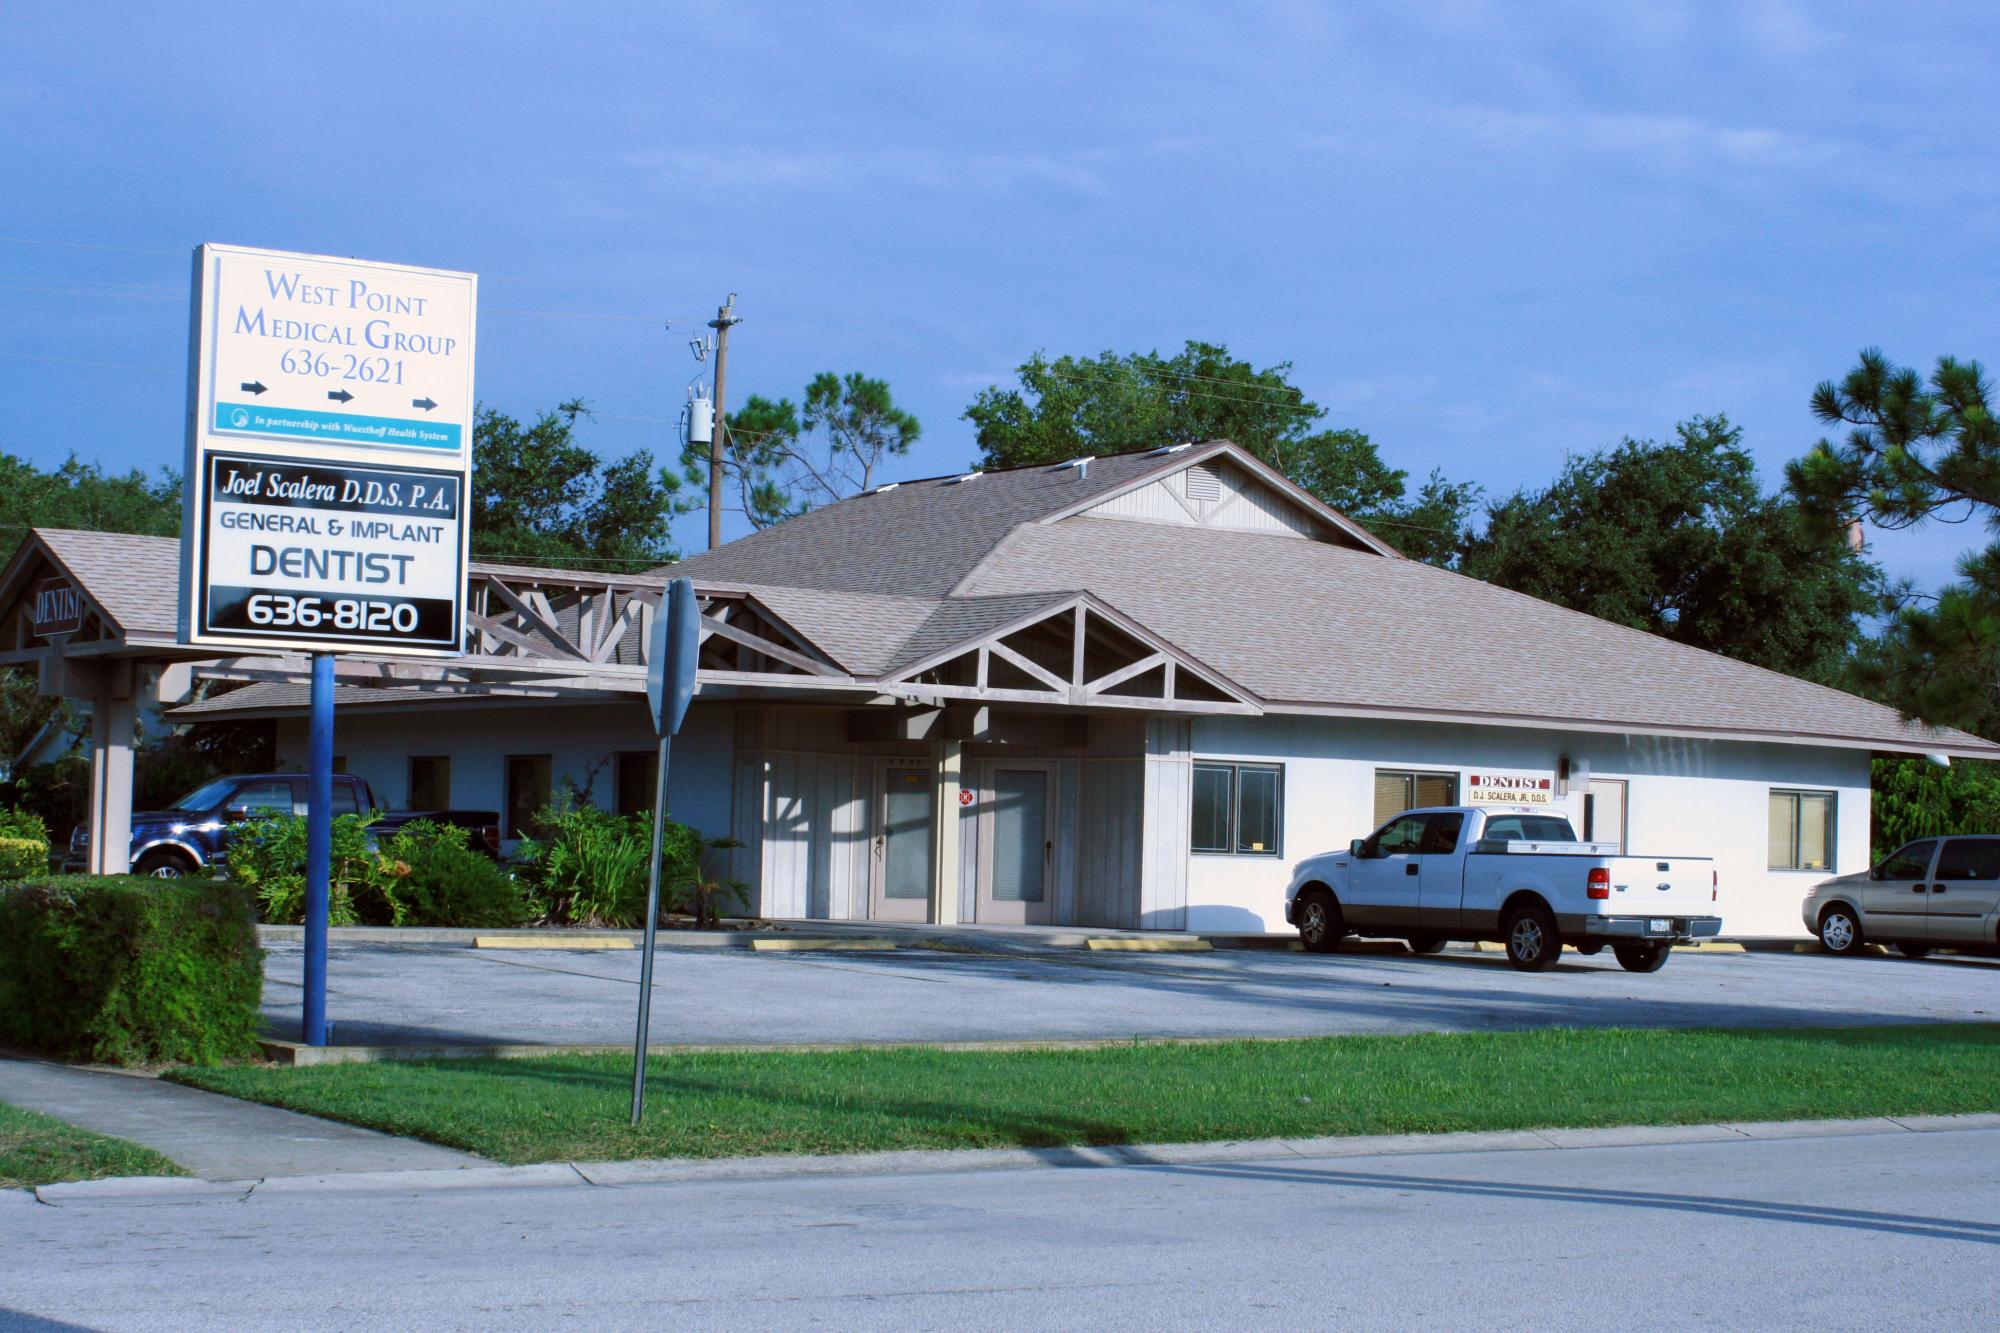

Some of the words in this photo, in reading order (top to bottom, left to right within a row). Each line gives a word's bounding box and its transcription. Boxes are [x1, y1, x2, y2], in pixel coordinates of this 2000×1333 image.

[264, 269, 340, 307] WEST
[347, 279, 428, 317] POINT
[233, 304, 357, 346] MEDICAL
[364, 319, 456, 357] GROUP
[280, 348, 405, 385] 636-2621
[255, 415, 265, 425] In
[266, 417, 319, 431] partnership
[321, 421, 341, 431] with
[343, 423, 386, 437] Wuesthoff
[387, 427, 417, 439] Health
[418, 430, 449, 441] System
[222, 469, 262, 496] Joel
[266, 472, 336, 502] Scalera
[340, 479, 404, 508] D.D.S.
[408, 484, 451, 511] P.A.
[220, 511, 322, 536] GENERAL
[327, 518, 345, 537] &
[351, 520, 445, 544] IMPLANT
[250, 544, 415, 585] DENTIST
[247, 594, 420, 633] 636-8120
[1479, 776, 1542, 789] DENTIST
